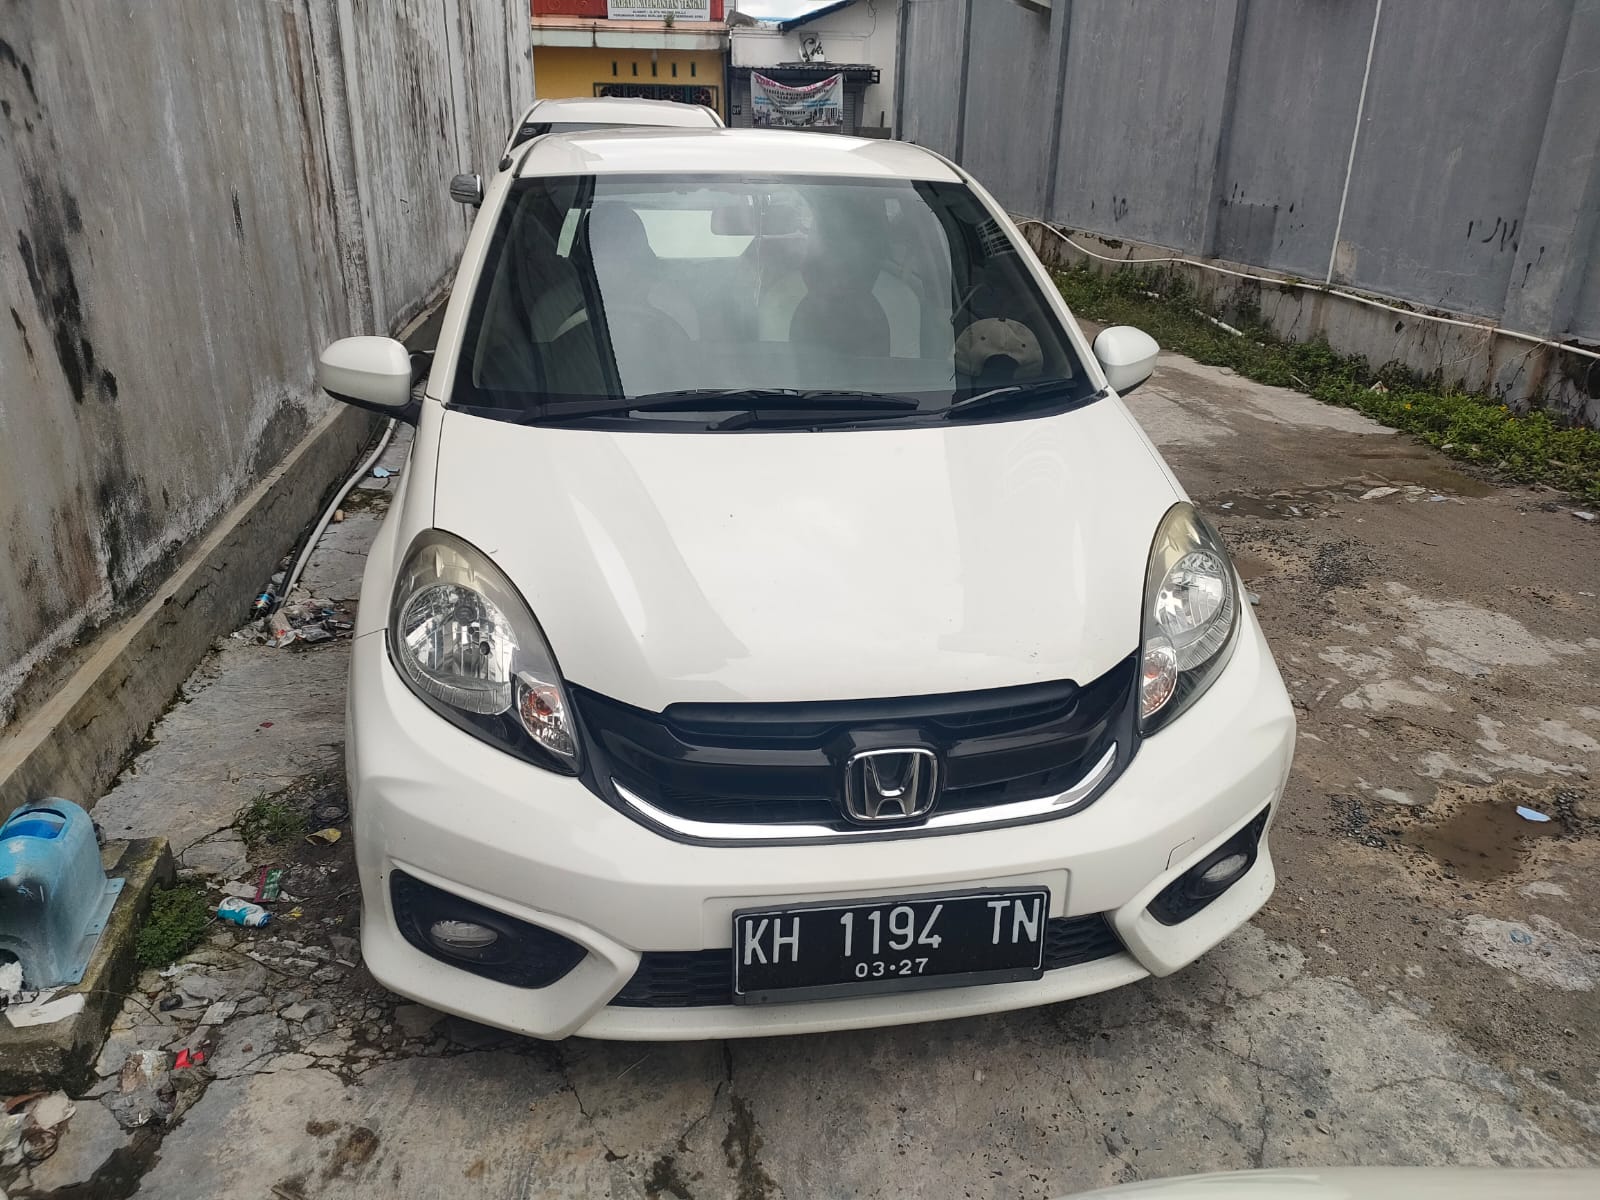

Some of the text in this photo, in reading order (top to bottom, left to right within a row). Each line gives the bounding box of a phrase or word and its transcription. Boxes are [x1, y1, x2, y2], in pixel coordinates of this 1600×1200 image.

[744, 898, 1041, 965] KH 1194 TN
